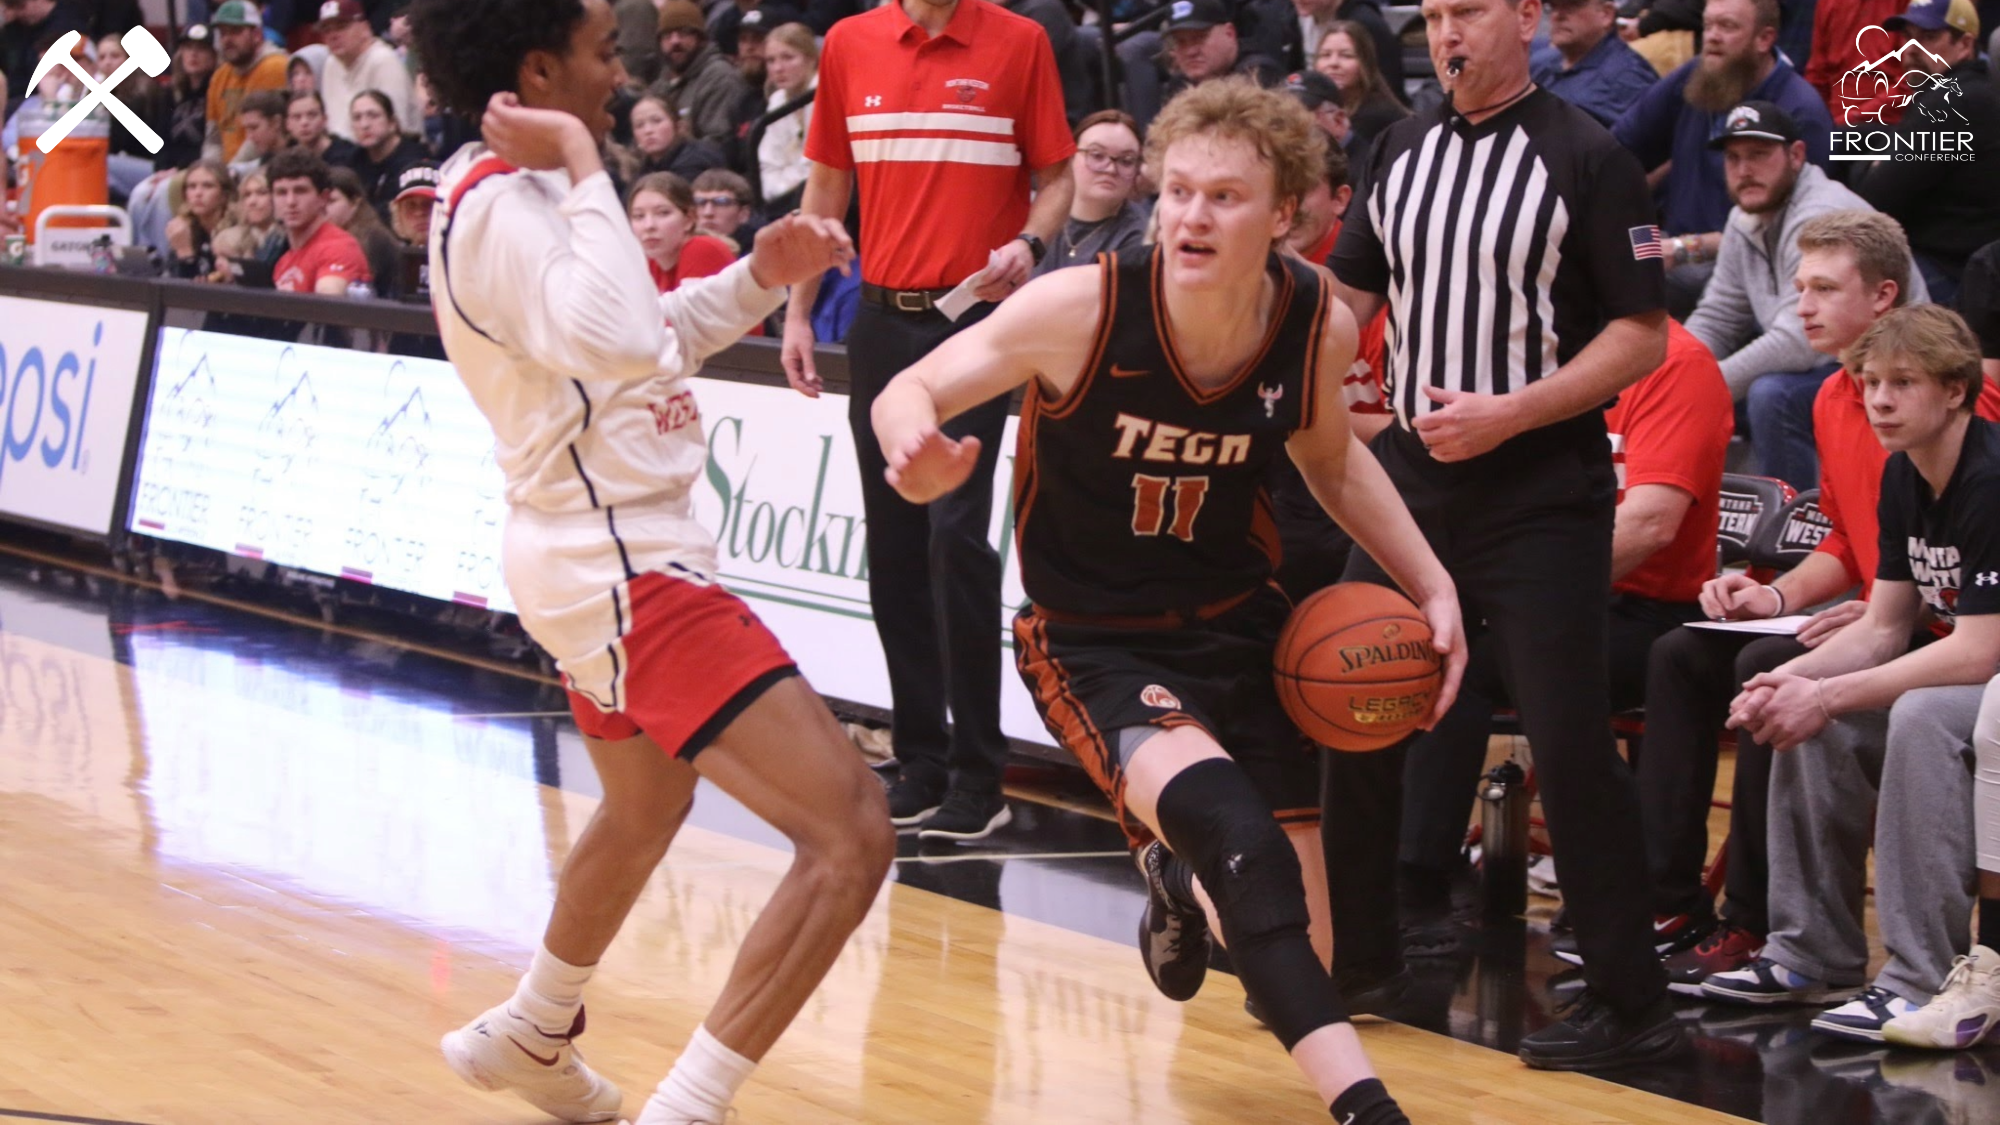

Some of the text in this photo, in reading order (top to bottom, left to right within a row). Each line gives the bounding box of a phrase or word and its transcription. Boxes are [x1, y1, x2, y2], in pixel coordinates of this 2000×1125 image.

[0, 320, 103, 492] psi
[1131, 473, 1209, 542] 11
[1719, 511, 1758, 537] TERN
